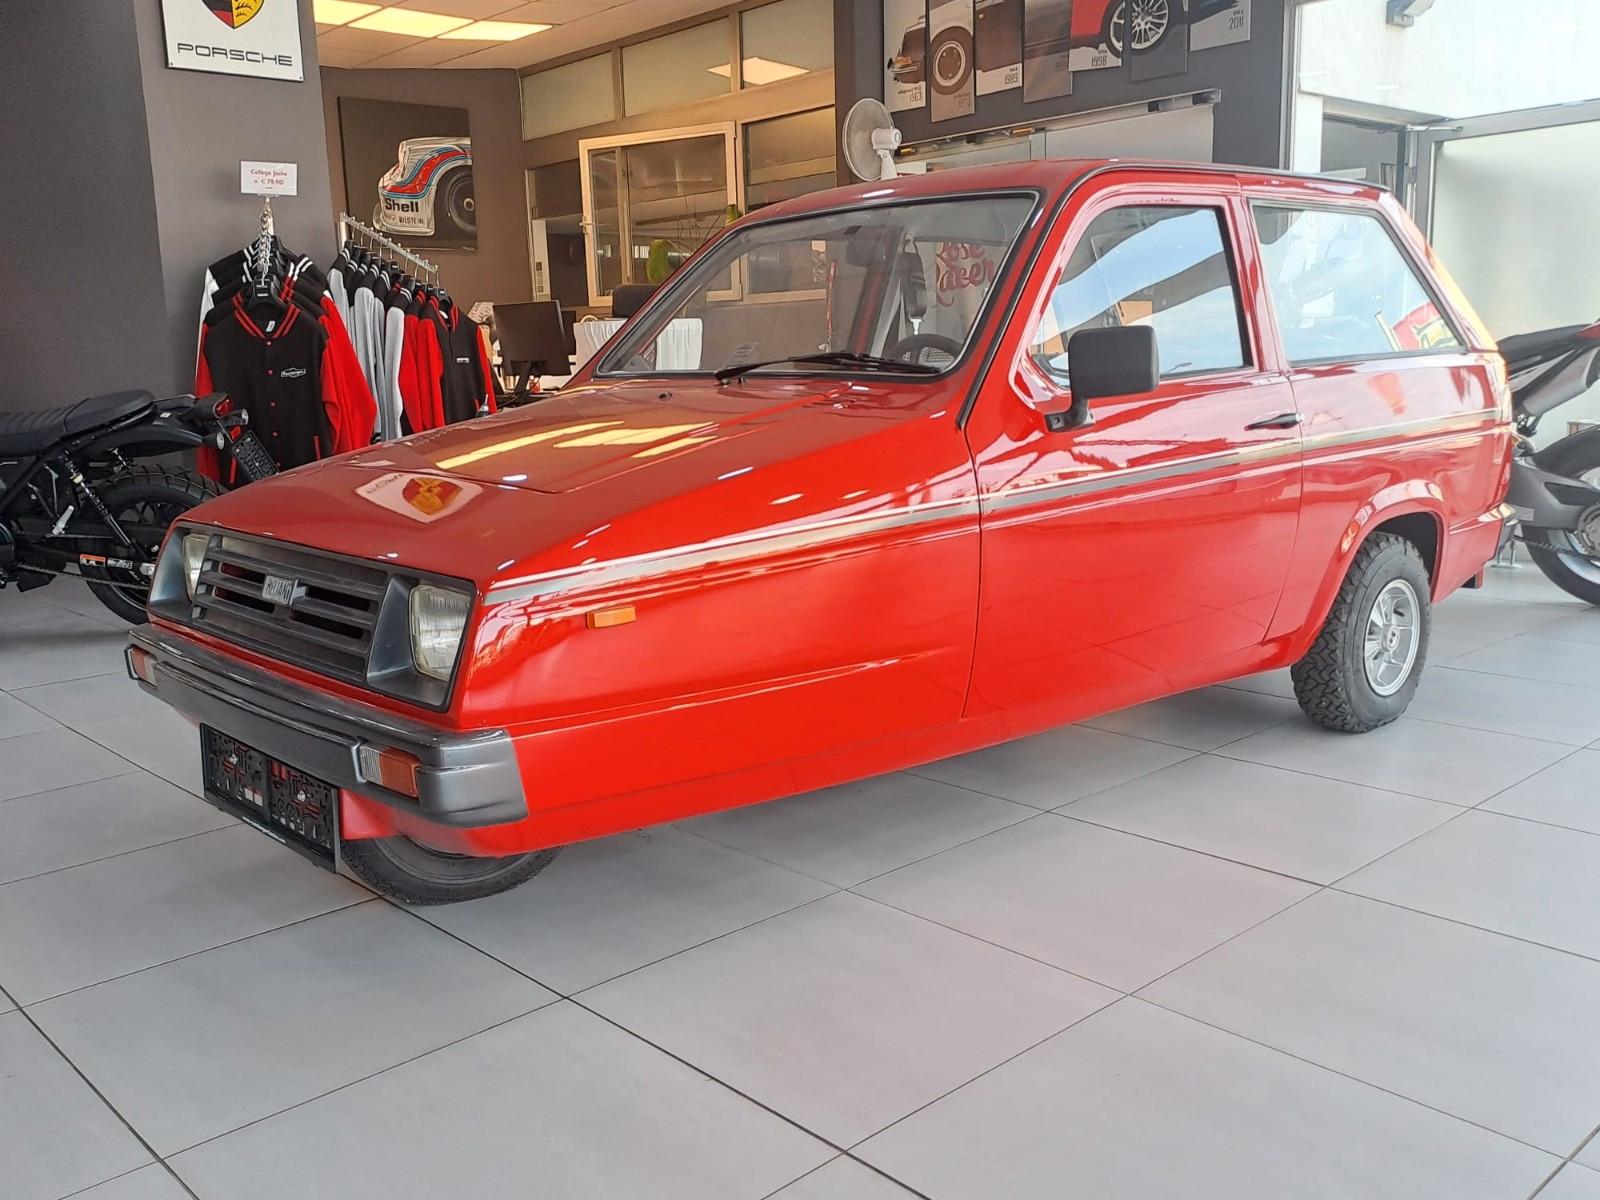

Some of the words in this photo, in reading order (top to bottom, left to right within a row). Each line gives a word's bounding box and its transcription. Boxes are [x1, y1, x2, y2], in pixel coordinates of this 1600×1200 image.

[177, 42, 293, 67] PORSCHE
[1092, 55, 1107, 67] 1998
[385, 198, 419, 212] Shell
